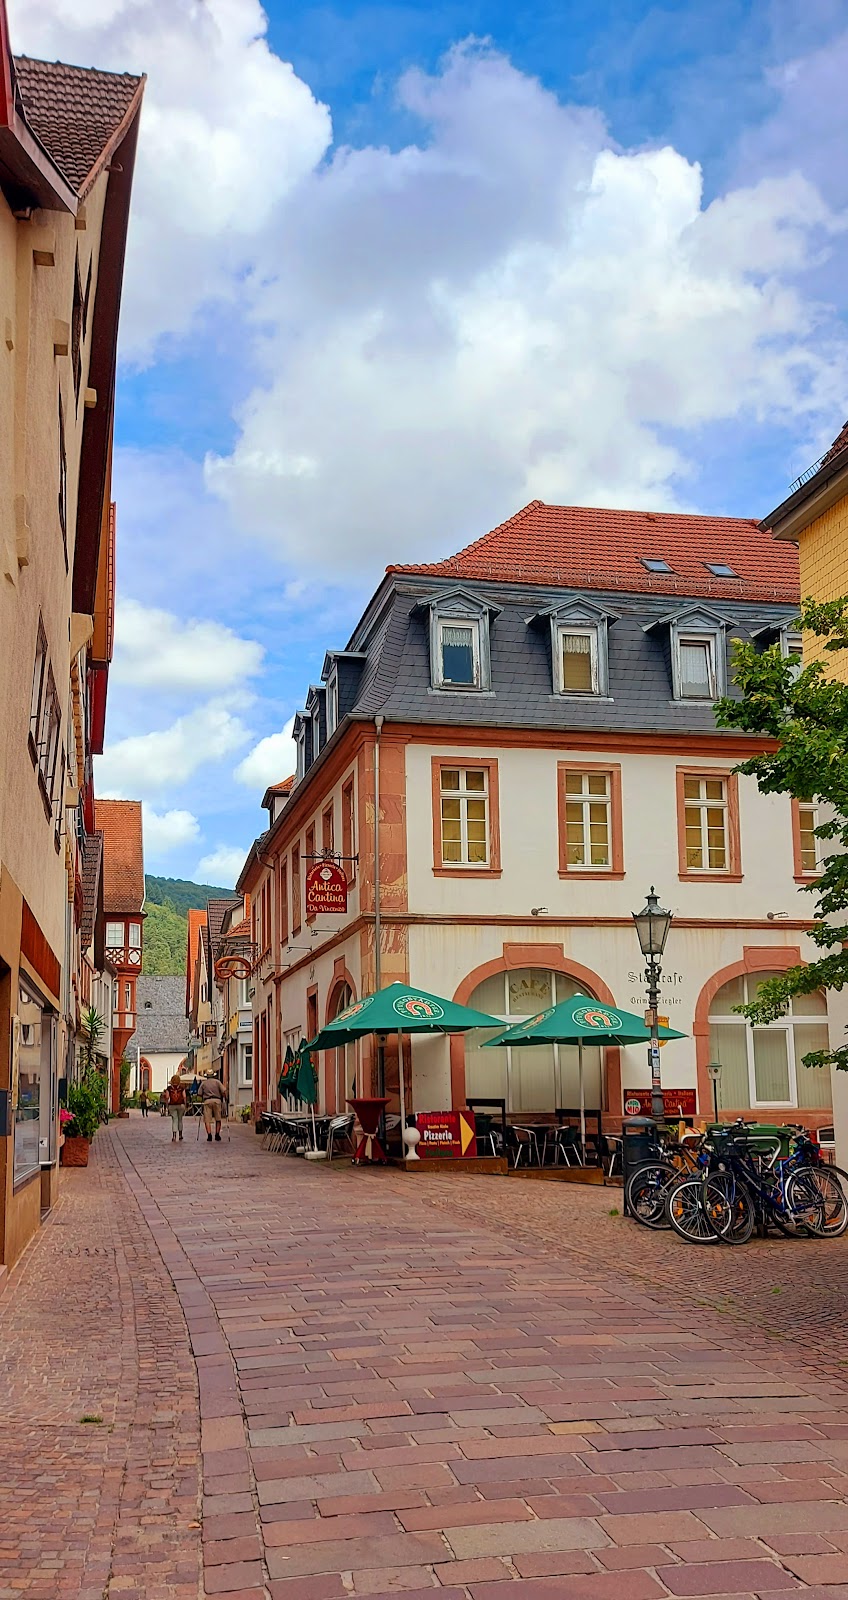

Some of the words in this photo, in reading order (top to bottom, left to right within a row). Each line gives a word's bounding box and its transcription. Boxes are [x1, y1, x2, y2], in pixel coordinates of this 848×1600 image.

[309, 881, 343, 892] Antica
[308, 891, 346, 903] Cantina
[418, 1113, 456, 1124] Ristorante
[423, 1130, 453, 1140] Pizzeria
